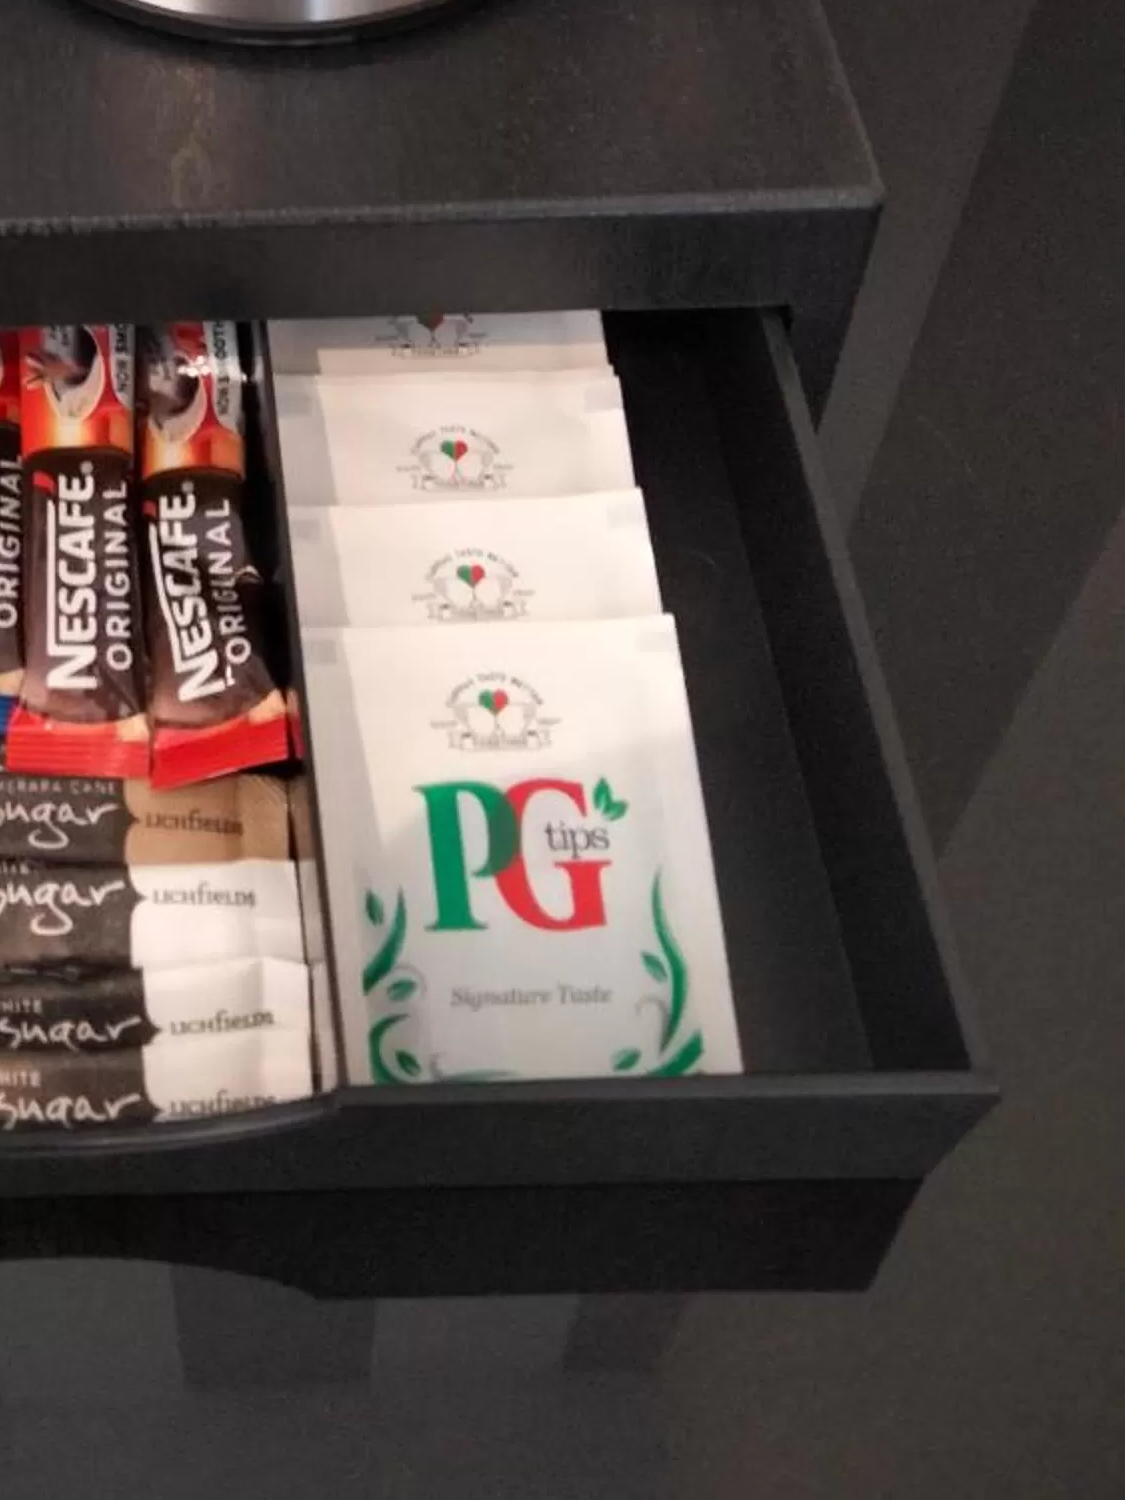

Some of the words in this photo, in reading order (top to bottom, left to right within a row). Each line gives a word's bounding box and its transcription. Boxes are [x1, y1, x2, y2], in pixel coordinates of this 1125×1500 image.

[105, 481, 133, 672] ORIGINAL
[205, 498, 253, 666] ORIGINAL
[413, 777, 612, 932] PG
[544, 820, 611, 859] tips
